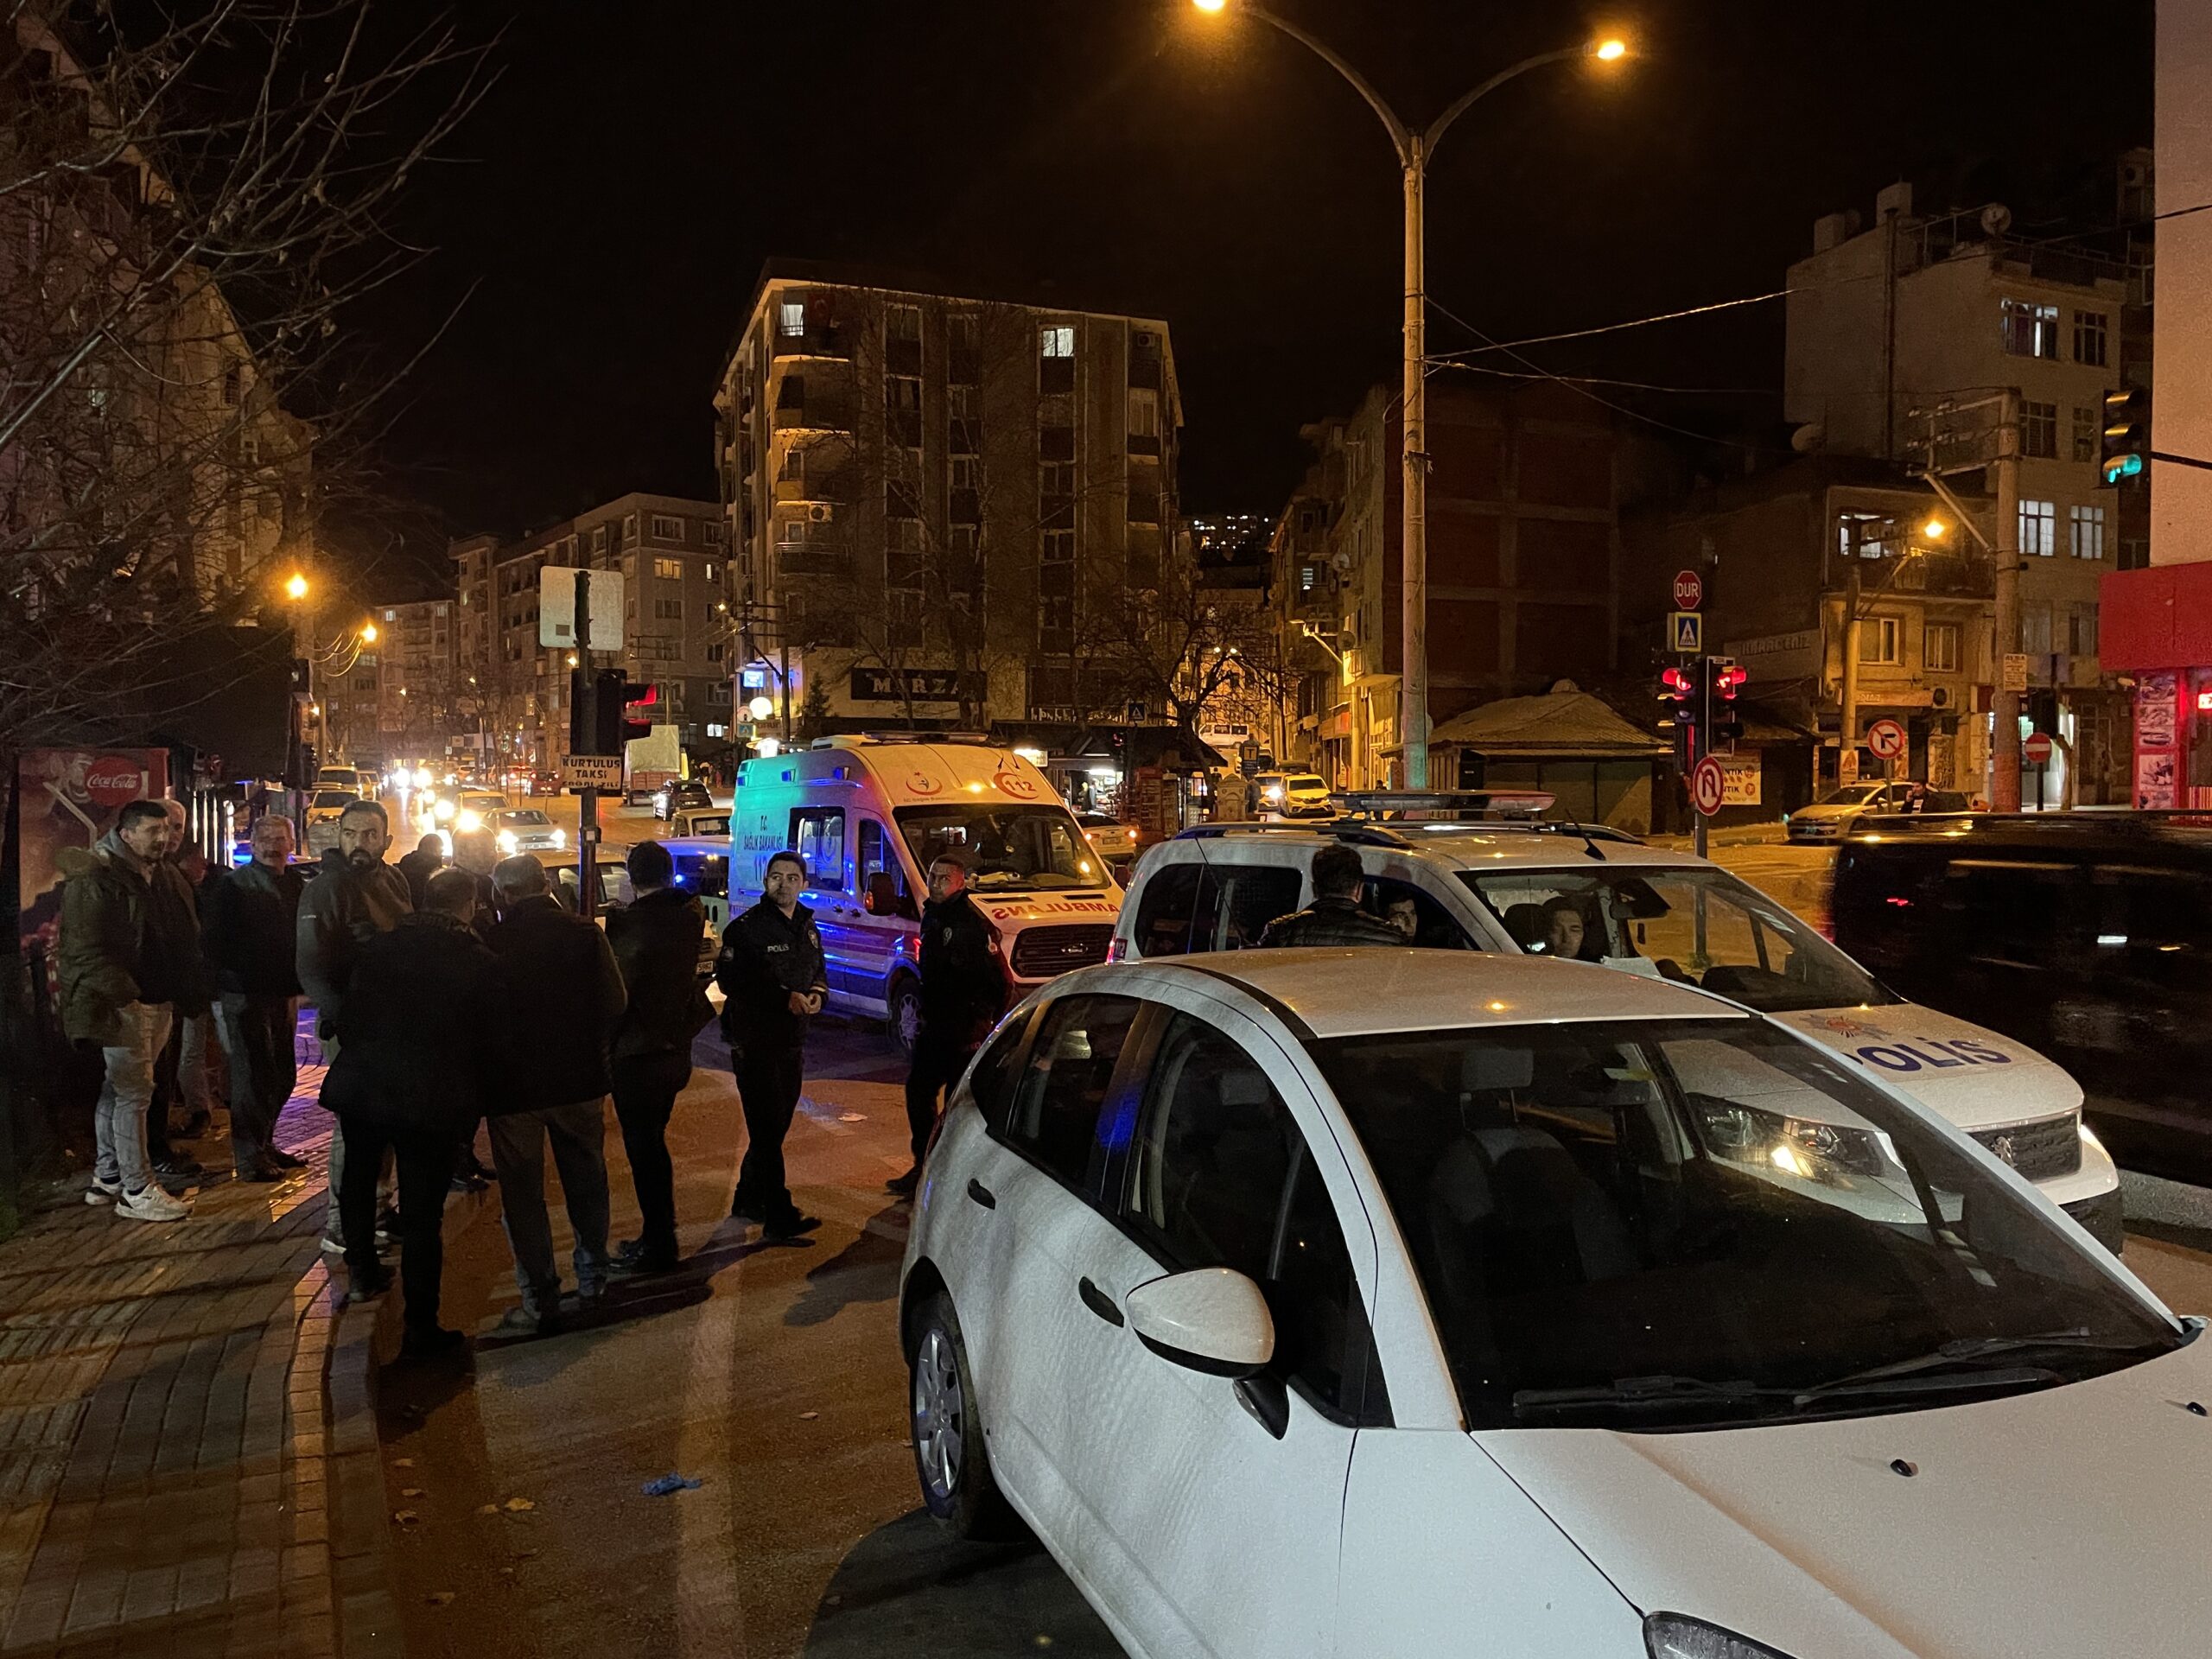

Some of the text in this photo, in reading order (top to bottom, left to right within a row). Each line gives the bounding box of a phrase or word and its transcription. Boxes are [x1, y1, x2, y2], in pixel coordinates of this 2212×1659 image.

[1676, 582, 1699, 598] DUR
[87, 773, 138, 789] Coca-Cola
[1005, 779, 1037, 792] 112
[1841, 1037, 2012, 1071] OLİS
